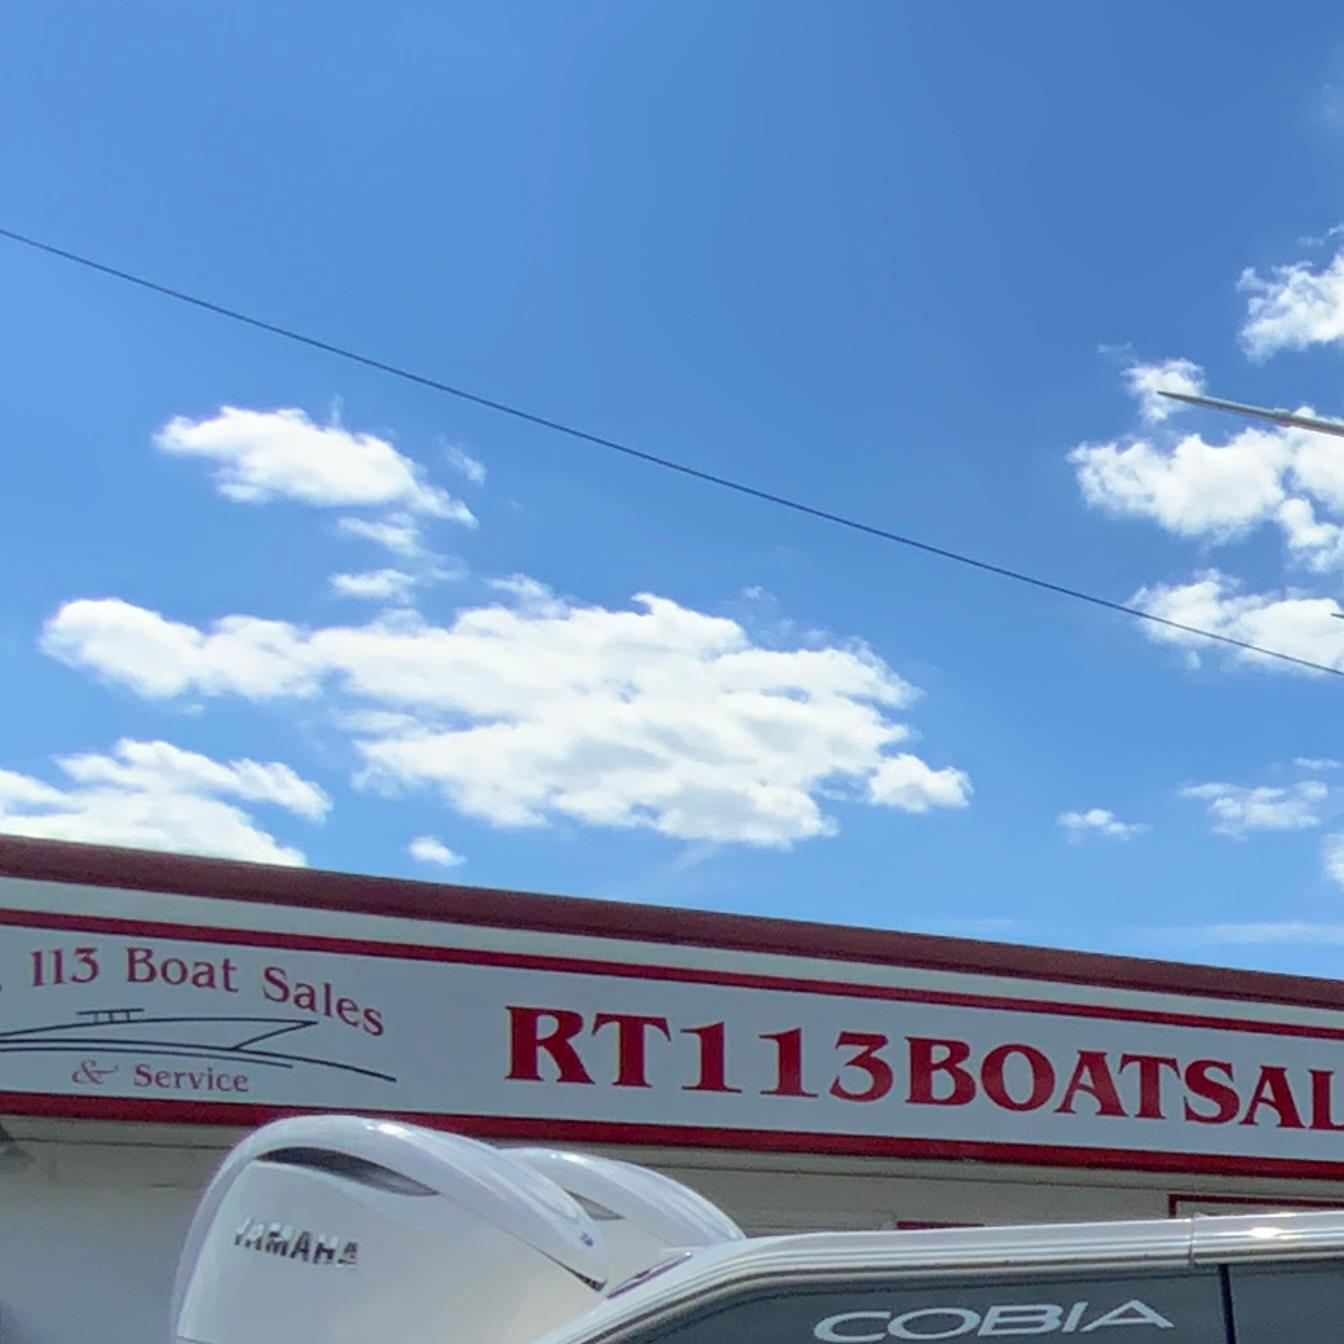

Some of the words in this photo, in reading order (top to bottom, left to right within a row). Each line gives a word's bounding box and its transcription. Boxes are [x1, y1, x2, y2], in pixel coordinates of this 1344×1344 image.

[30, 947, 100, 987] 113
[126, 947, 239, 993] Boat
[262, 966, 385, 1037] Sales
[71, 1059, 119, 1084] &
[134, 1063, 249, 1093] Service
[233, 1216, 359, 1267] YAMAHA
[813, 1299, 1175, 1344] COBIA
